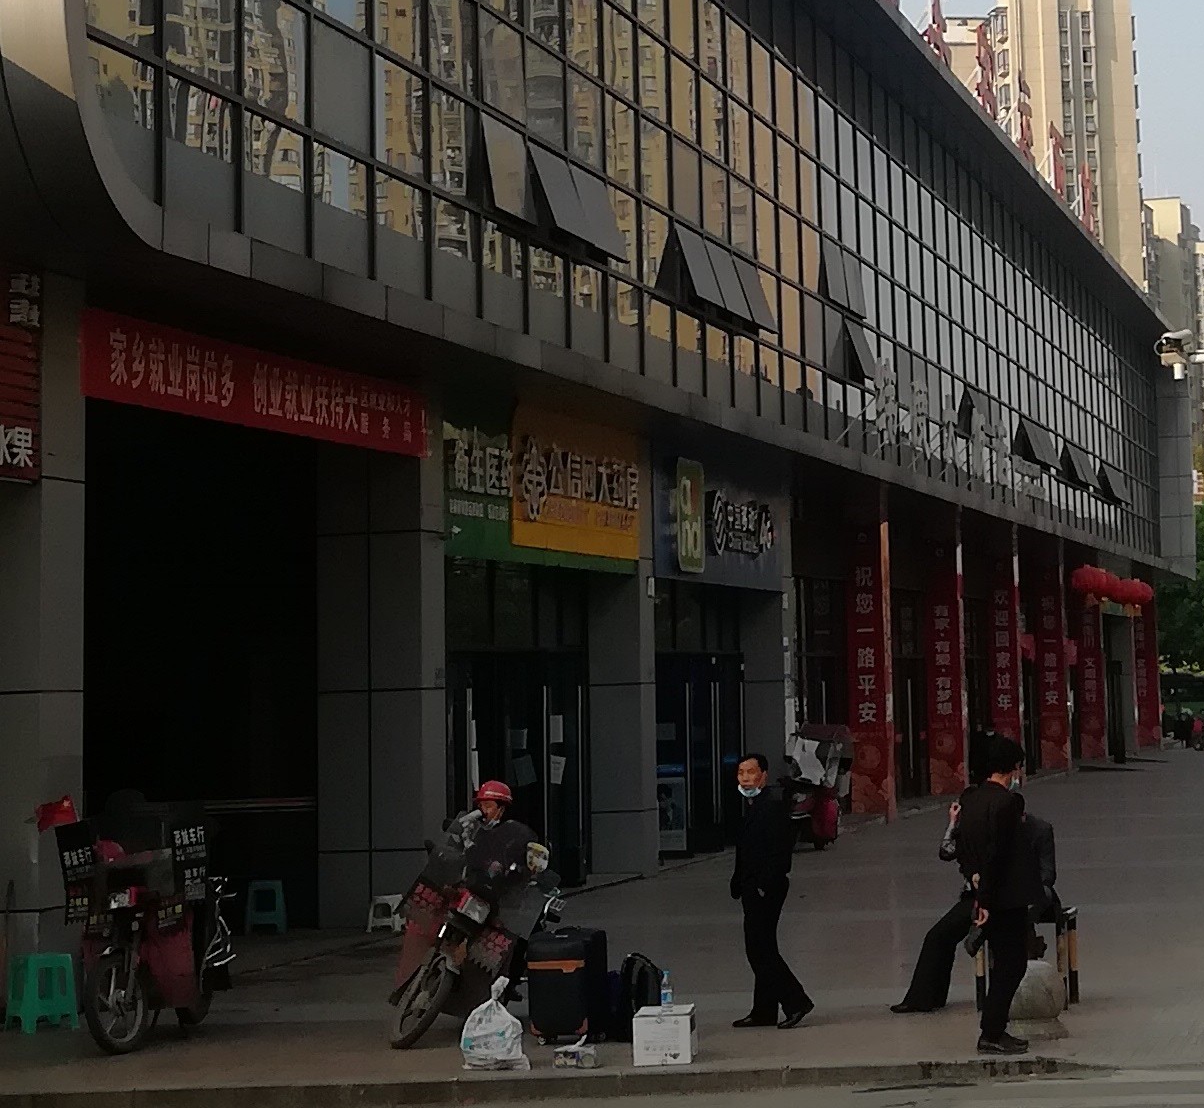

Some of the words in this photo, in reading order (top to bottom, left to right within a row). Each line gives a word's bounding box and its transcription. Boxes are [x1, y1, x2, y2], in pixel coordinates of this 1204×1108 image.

[109, 328, 235, 407] 家乡就业岗位多
[855, 565, 878, 724] 祝您一路平安
[993, 589, 1013, 711] 欢迎回家过年
[1041, 595, 1060, 706] 祝您一路平安
